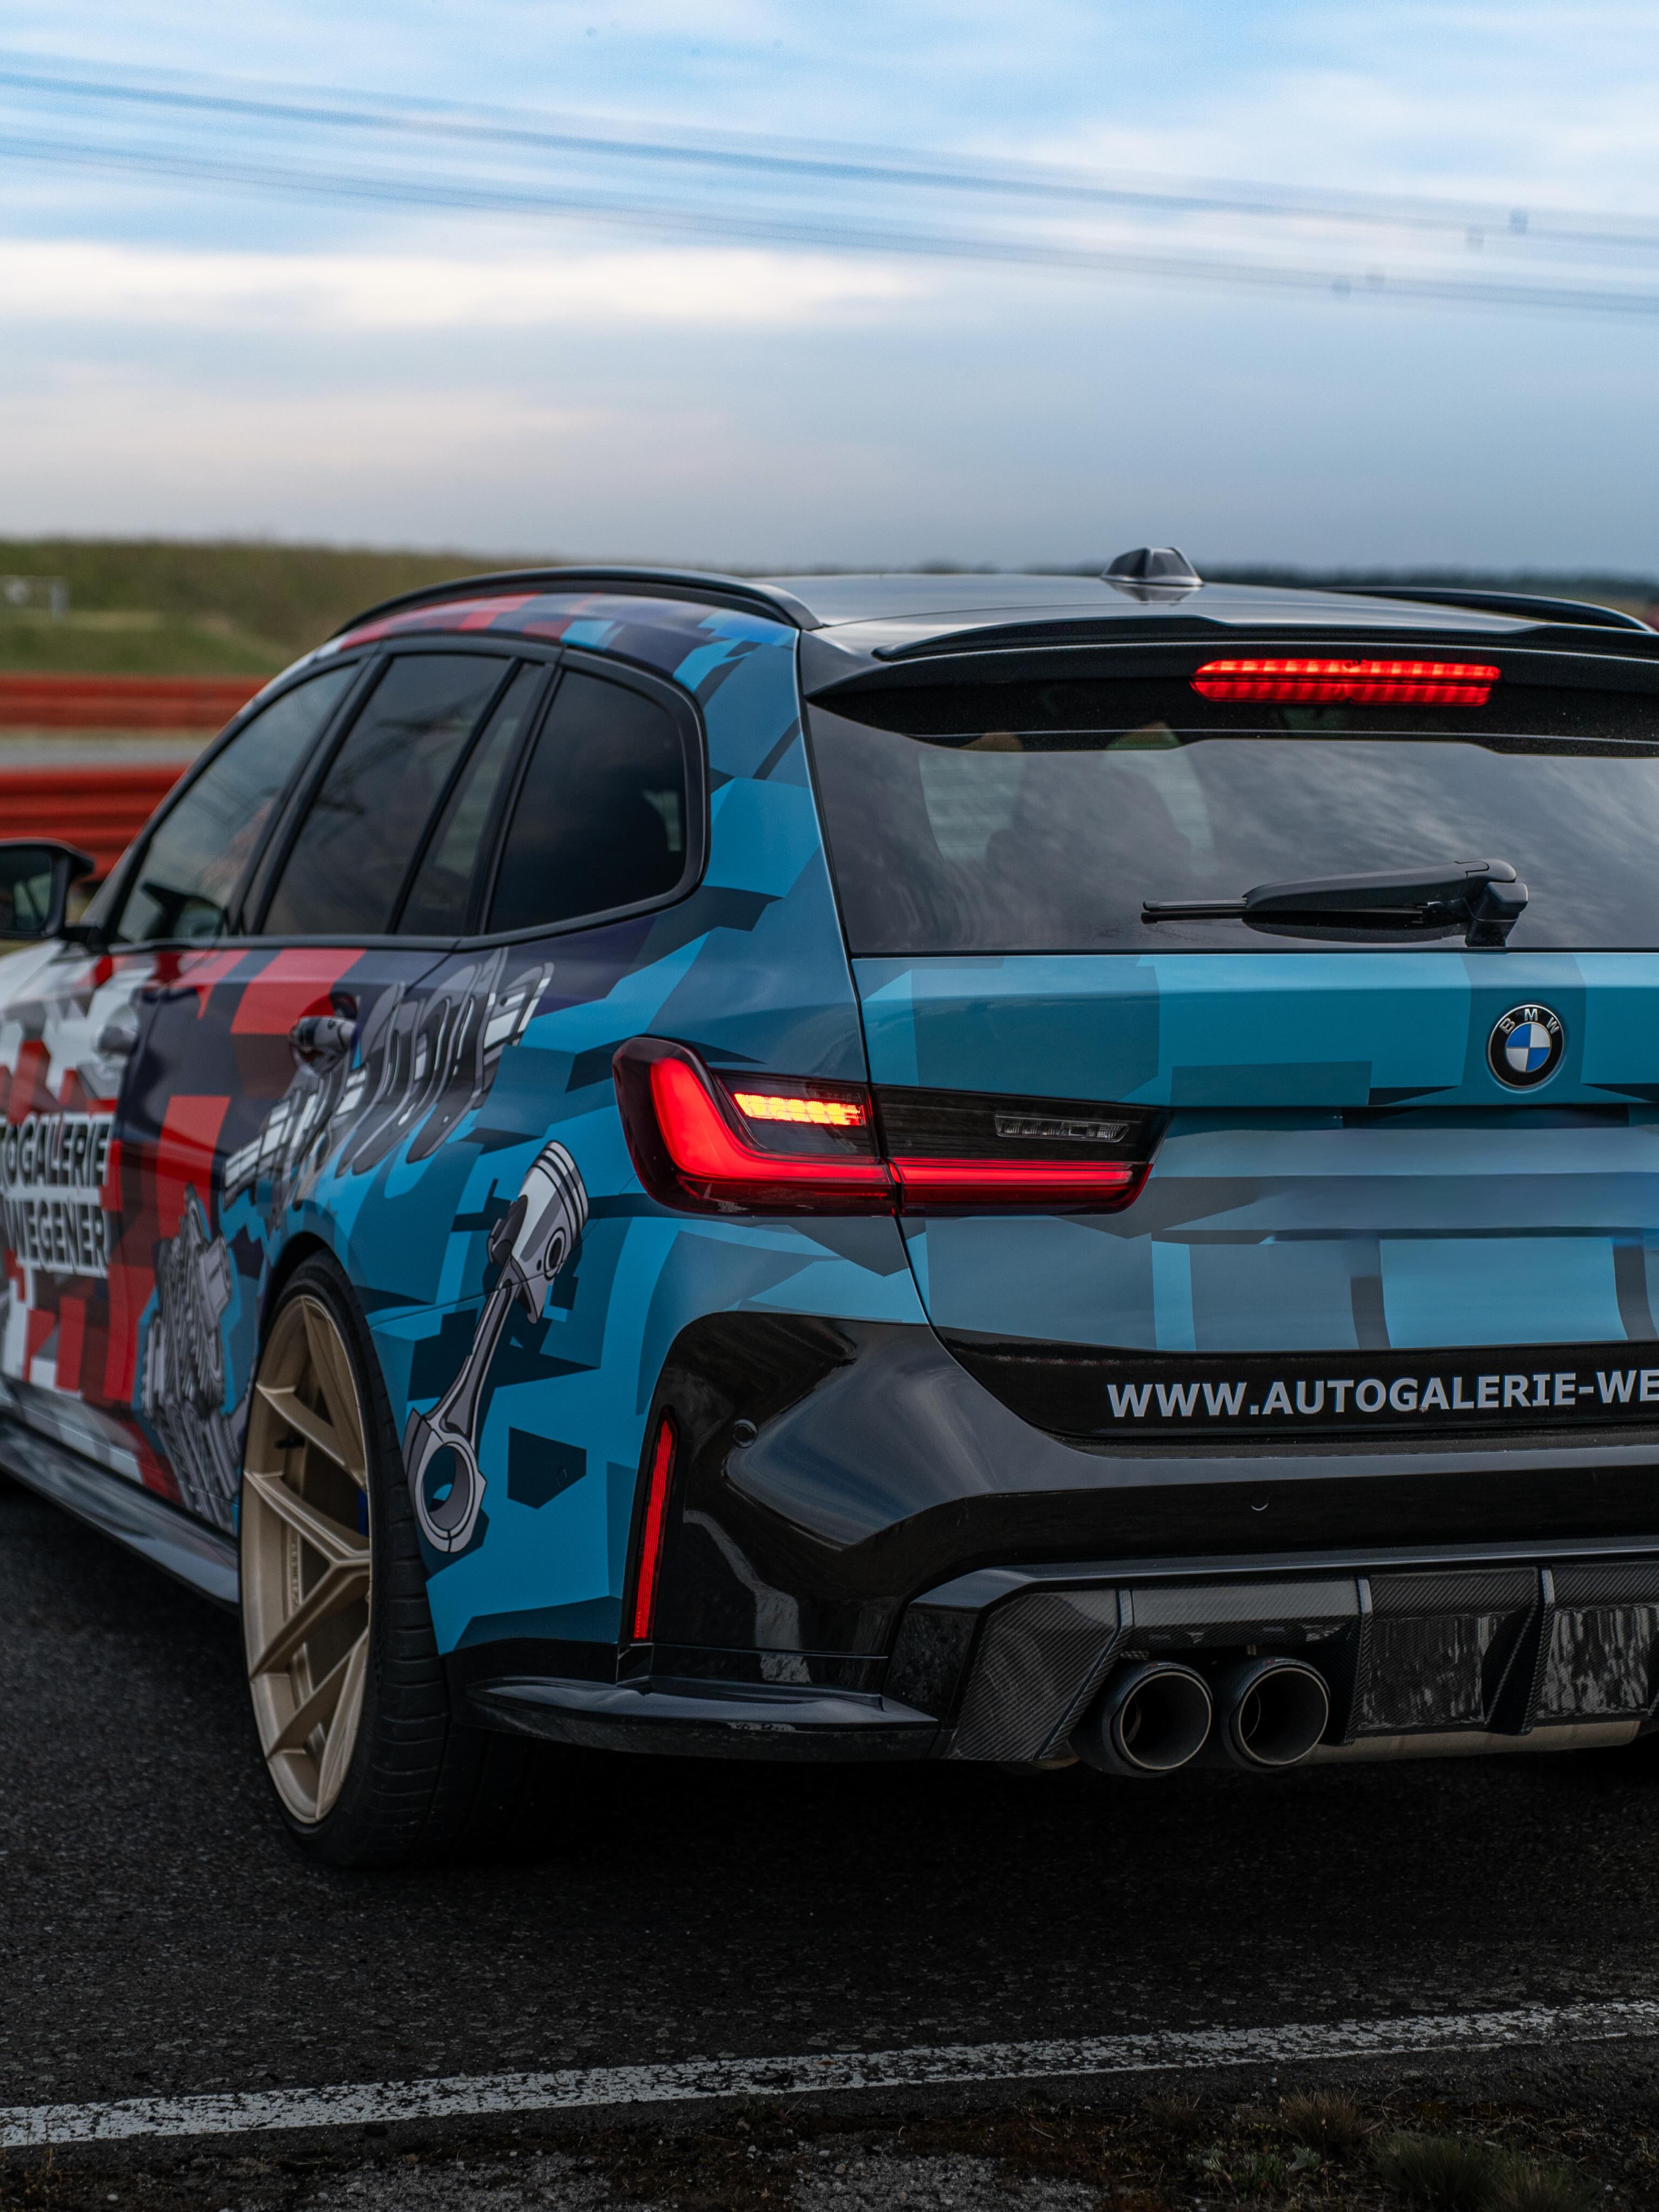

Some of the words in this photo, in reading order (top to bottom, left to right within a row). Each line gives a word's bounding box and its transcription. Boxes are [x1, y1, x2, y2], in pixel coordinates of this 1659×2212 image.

[1499, 1008, 1560, 1035] BMW
[0, 1117, 111, 1188] OGALERIE
[3, 1199, 109, 1272] WEGENER
[1107, 1370, 1659, 1418] WWW.AUTOGALERIE-WE
